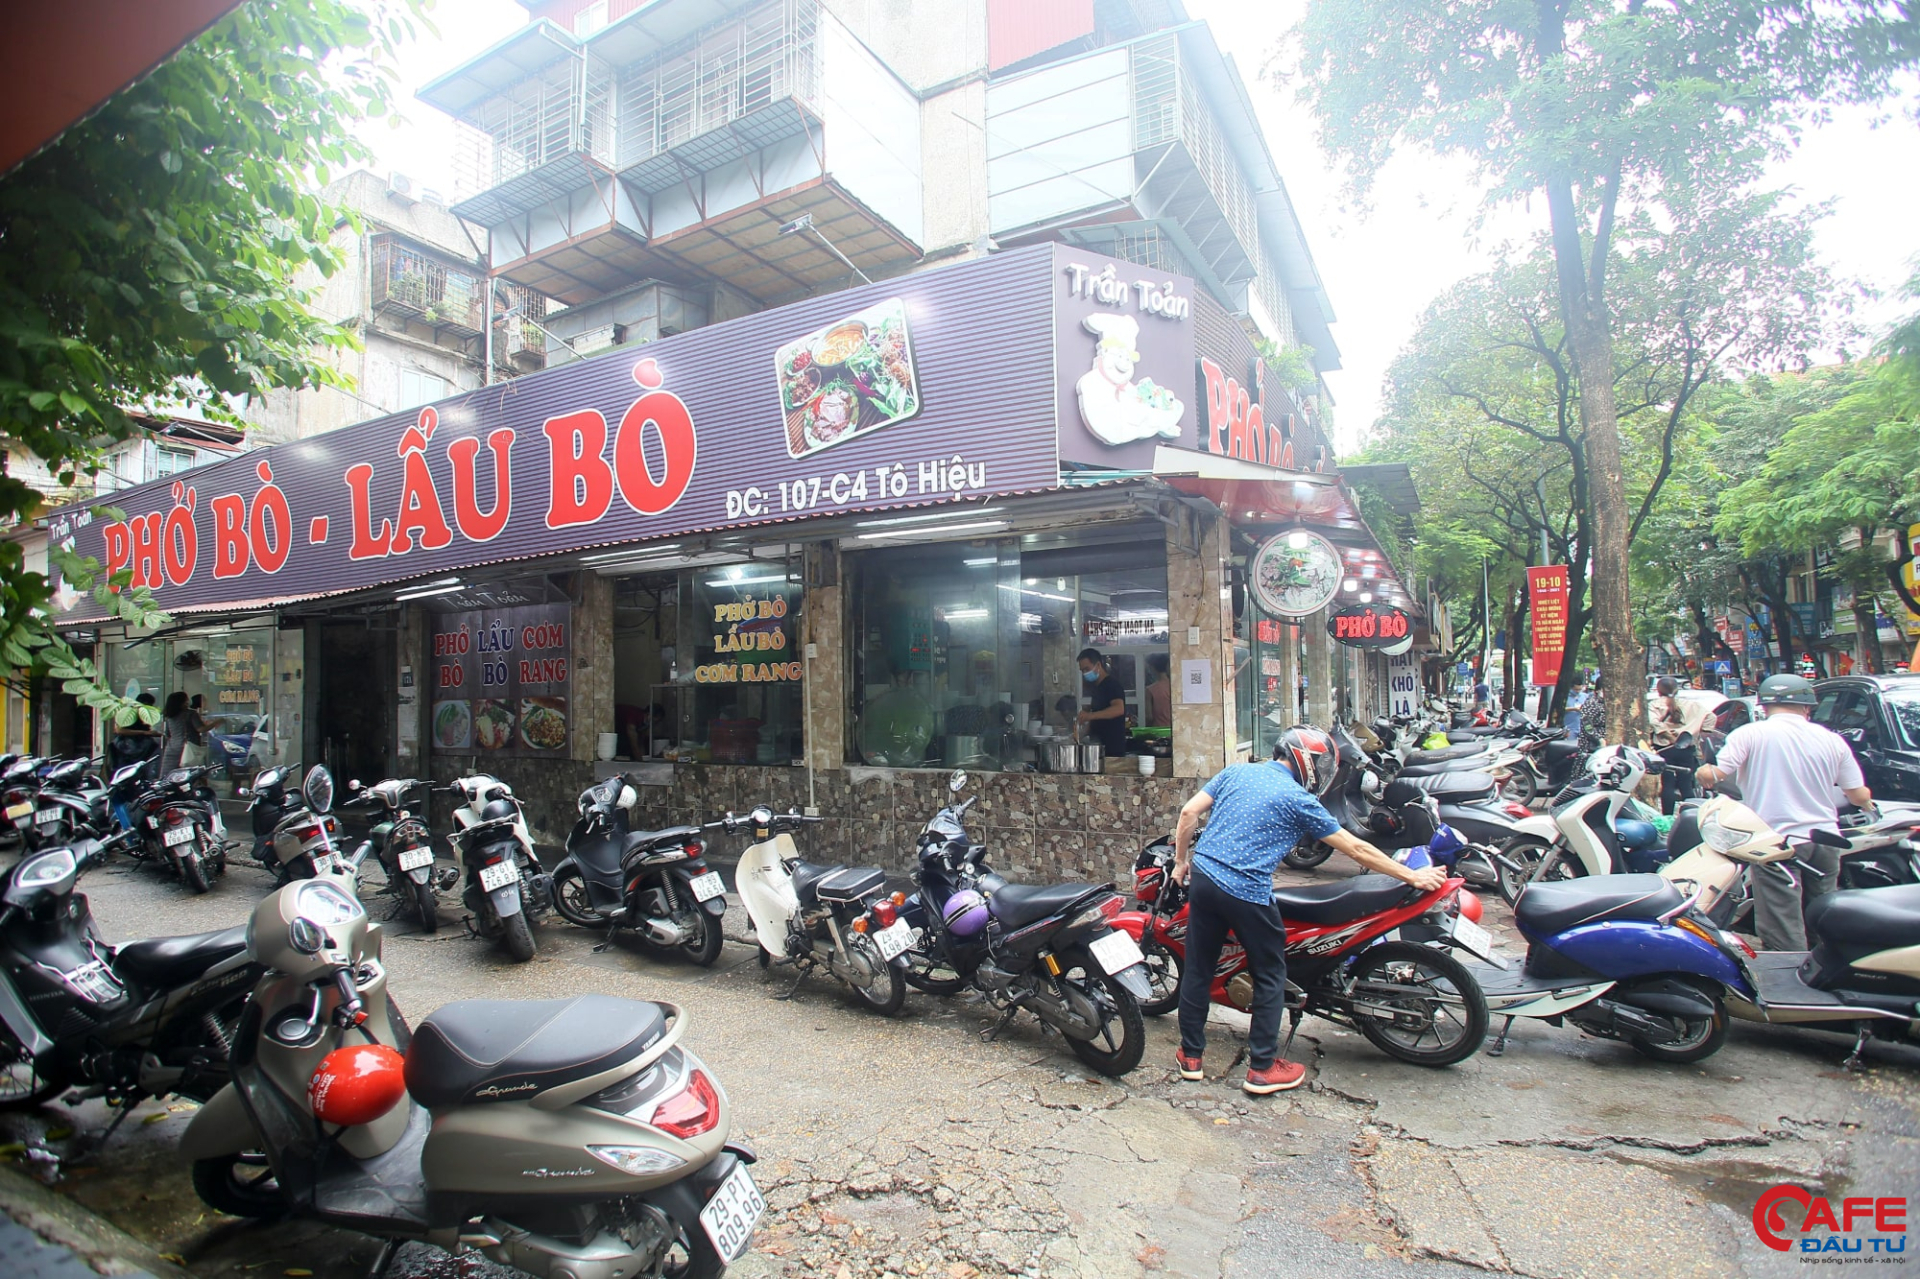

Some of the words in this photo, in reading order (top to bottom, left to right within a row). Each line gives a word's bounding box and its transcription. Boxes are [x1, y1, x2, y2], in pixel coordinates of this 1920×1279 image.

[1065, 263, 1128, 306] Trần
[104, 481, 198, 593] PHỞ
[211, 460, 292, 579] BÒ
[345, 406, 516, 560] LẨU
[543, 358, 697, 529] BÒ
[726, 486, 769, 519] ĐC:
[779, 470, 868, 511] 107-C4
[875, 462, 908, 498] Tô
[918, 454, 986, 501] Hiệu
[1535, 576, 1561, 589] 19-10
[714, 595, 756, 622] PHỞ
[758, 595, 787, 619] BÒ
[1336, 608, 1376, 638] PHỞ
[1379, 610, 1408, 638] BÒ
[434, 623, 470, 656] PHỞ
[477, 619, 515, 653] LẨU
[522, 620, 563, 650] CƠM
[714, 623, 756, 653] LẨU
[757, 626, 785, 650] BÒ
[440, 658, 464, 687] BÒ
[483, 655, 508, 686] BÒ
[519, 658, 567, 684] RANG
[695, 663, 737, 683] CƠM
[742, 662, 802, 682] RANG
[1307, 940, 1342, 955] SUZUKI
[480, 1082, 538, 1097] Grande
[709, 1174, 746, 1229] 29-P1
[719, 1191, 762, 1257] 809.96
